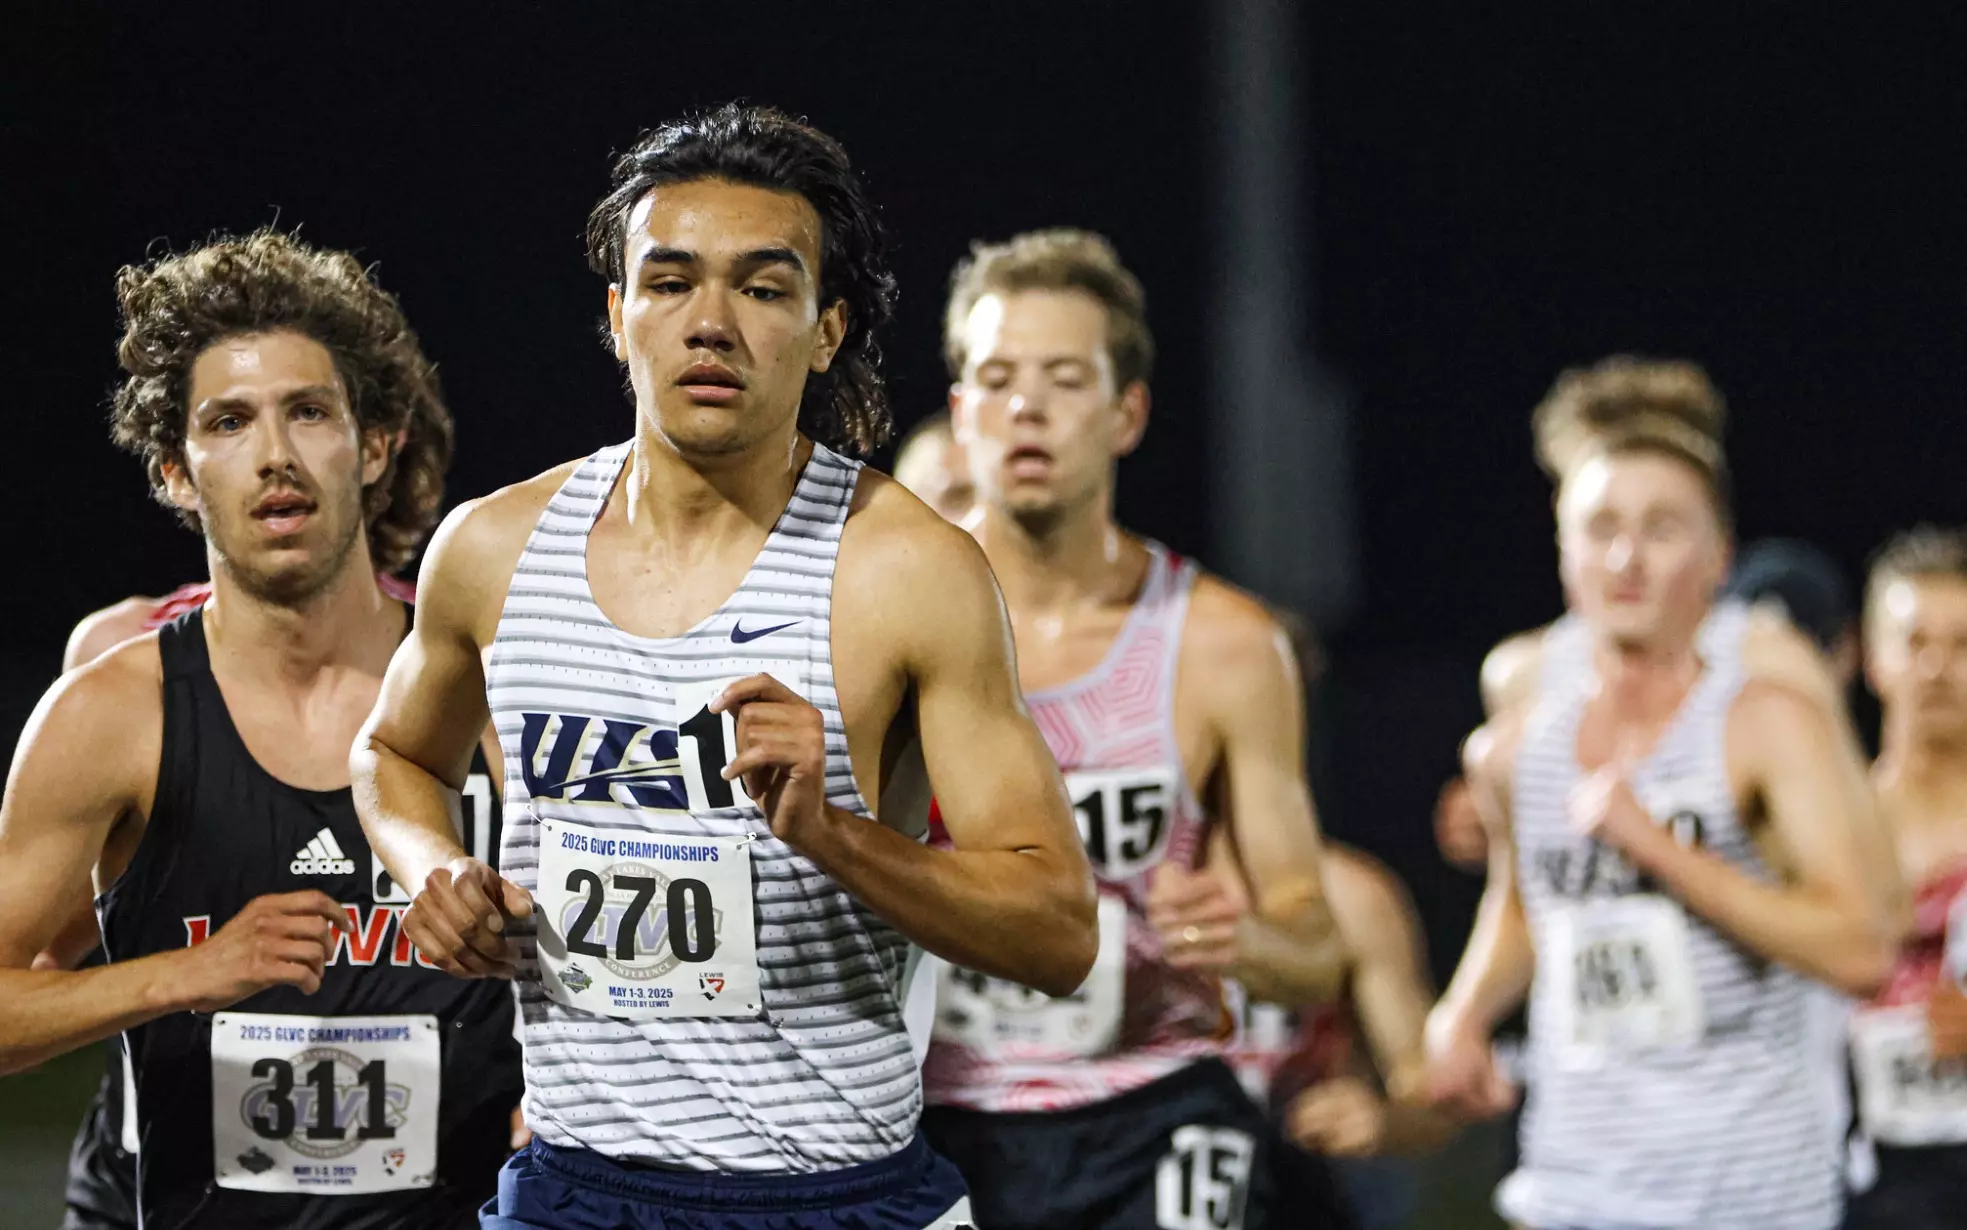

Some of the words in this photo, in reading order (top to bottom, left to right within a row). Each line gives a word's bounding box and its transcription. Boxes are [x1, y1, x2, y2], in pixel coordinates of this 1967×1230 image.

[1073, 784, 1163, 863] 15
[561, 832, 588, 852] 2025
[591, 838, 616, 856] GLVC
[619, 840, 719, 862] CHAMPIONSHIPS
[290, 859, 355, 875] adidas
[565, 868, 716, 963] 270
[608, 986, 627, 998] MAY
[648, 987, 674, 998] 2025
[613, 999, 638, 1007] HOSTED
[639, 999, 647, 1007] BY
[649, 999, 670, 1007] LEWIS
[240, 1025, 272, 1040] 2025
[275, 1027, 305, 1041] GLVC
[307, 1026, 411, 1043] CHAMPIONSHIPS
[251, 1058, 396, 1140] 311
[1178, 1148, 1238, 1230] 15
